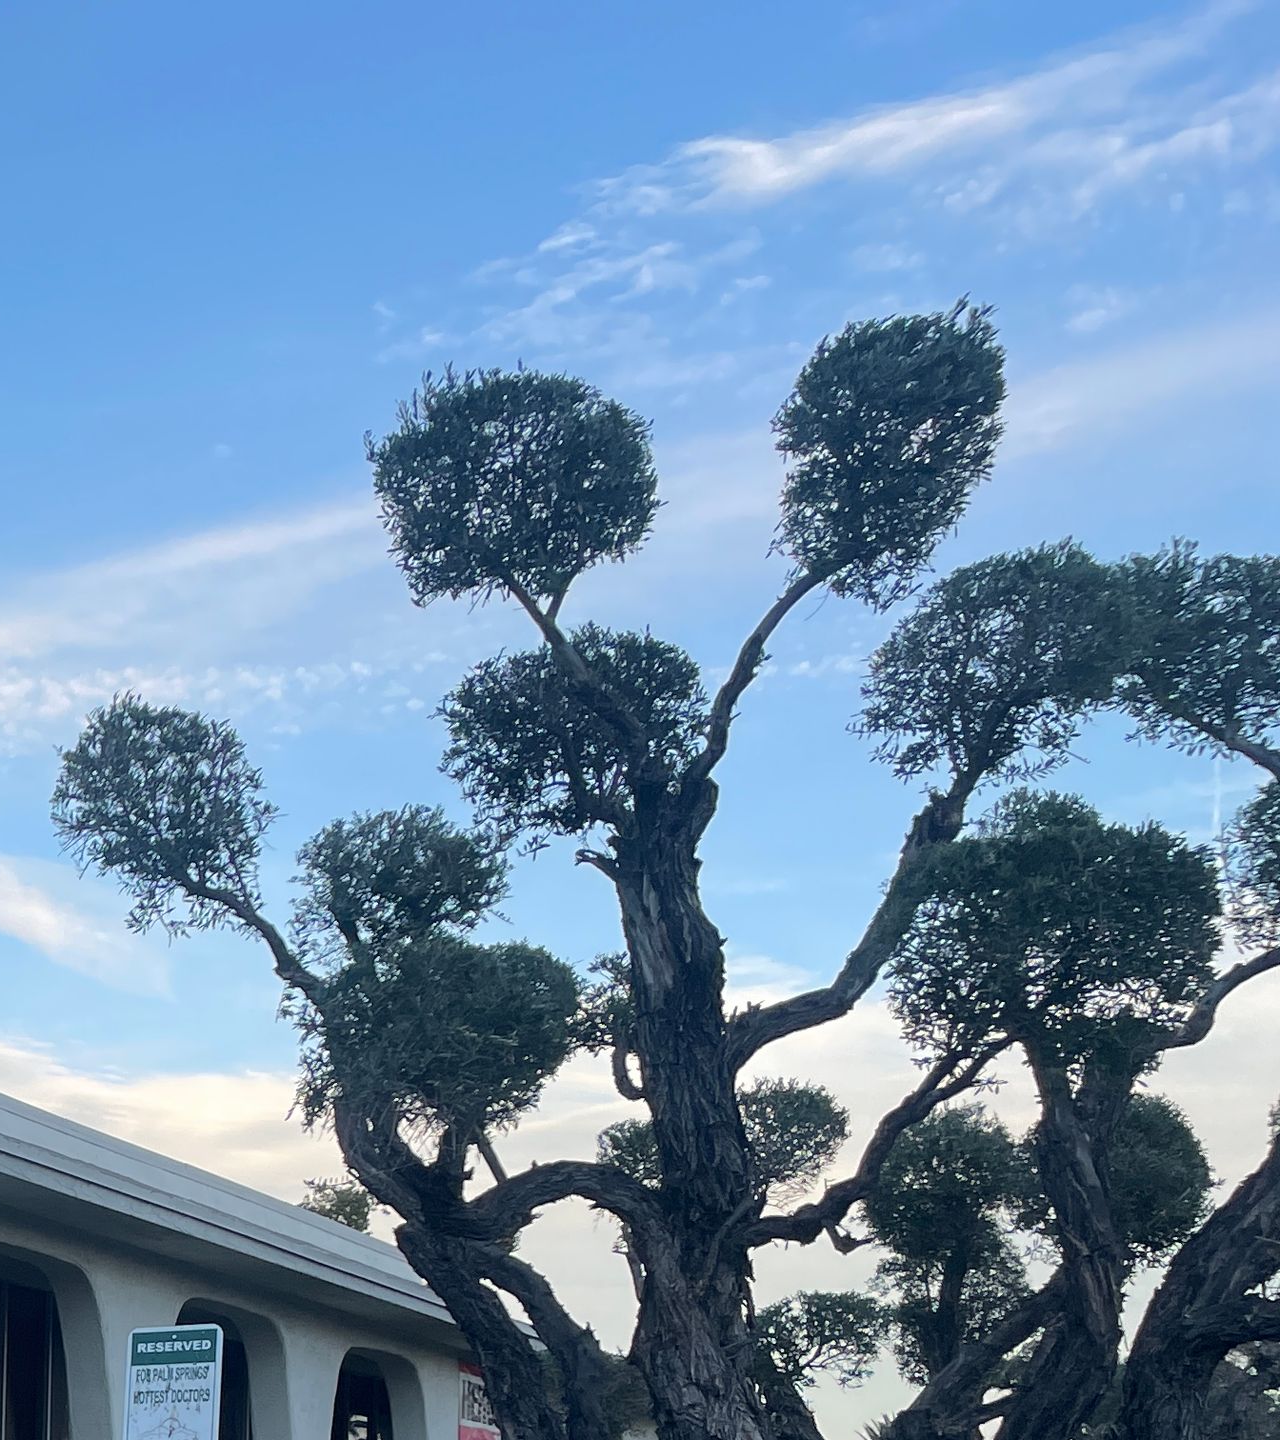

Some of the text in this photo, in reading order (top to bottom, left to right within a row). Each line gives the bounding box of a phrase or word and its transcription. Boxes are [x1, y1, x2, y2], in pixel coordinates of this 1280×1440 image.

[137, 1339, 212, 1353] RESERVED
[136, 1368, 151, 1383] FOR
[152, 1367, 174, 1382] PALM
[133, 1388, 211, 1405] HOTTEST DOCTORS
